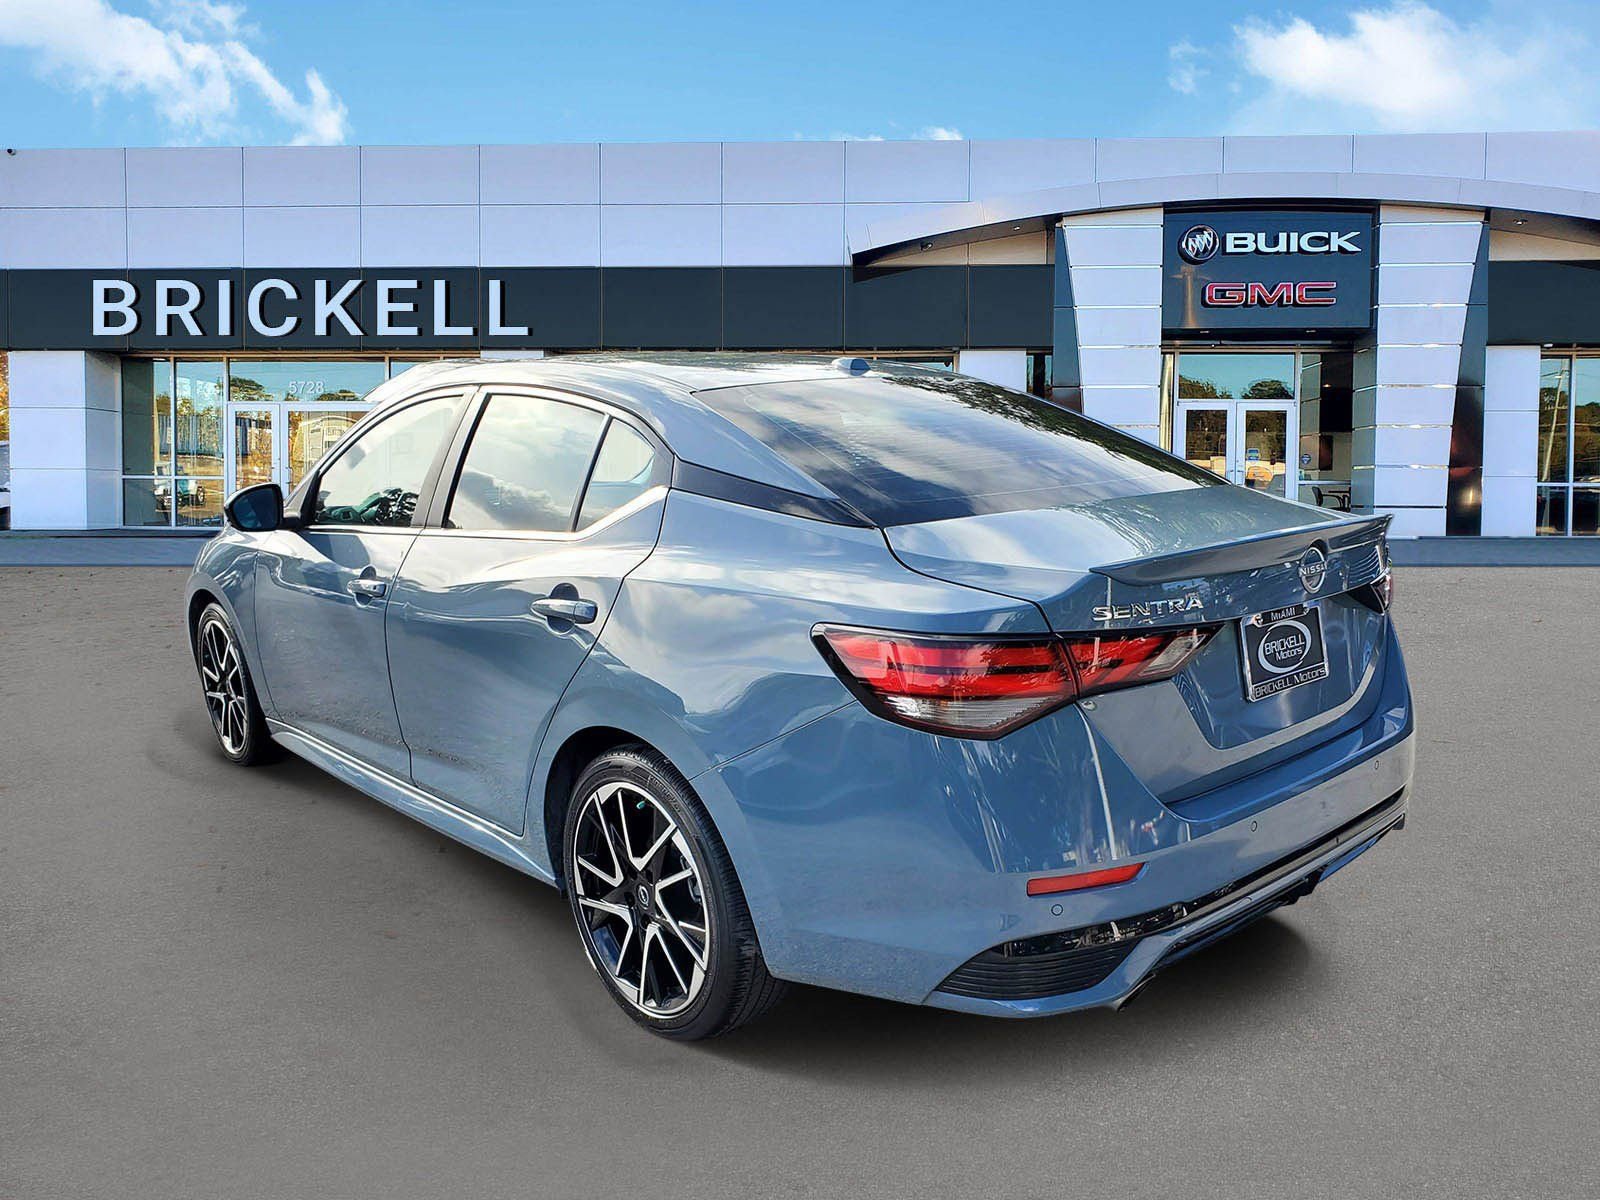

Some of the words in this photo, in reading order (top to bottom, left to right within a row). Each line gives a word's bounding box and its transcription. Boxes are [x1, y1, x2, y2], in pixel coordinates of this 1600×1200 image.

[1225, 231, 1362, 253] BUICK
[1205, 281, 1338, 306] GMC
[92, 278, 530, 337] BRICKELL
[288, 380, 325, 395] 5728
[1092, 593, 1204, 622] SENTRA
[1264, 634, 1305, 655] BRICKELL
[1276, 647, 1303, 661] Motors
[1255, 678, 1293, 697] BRICKELL
[1293, 668, 1326, 683] Motors
